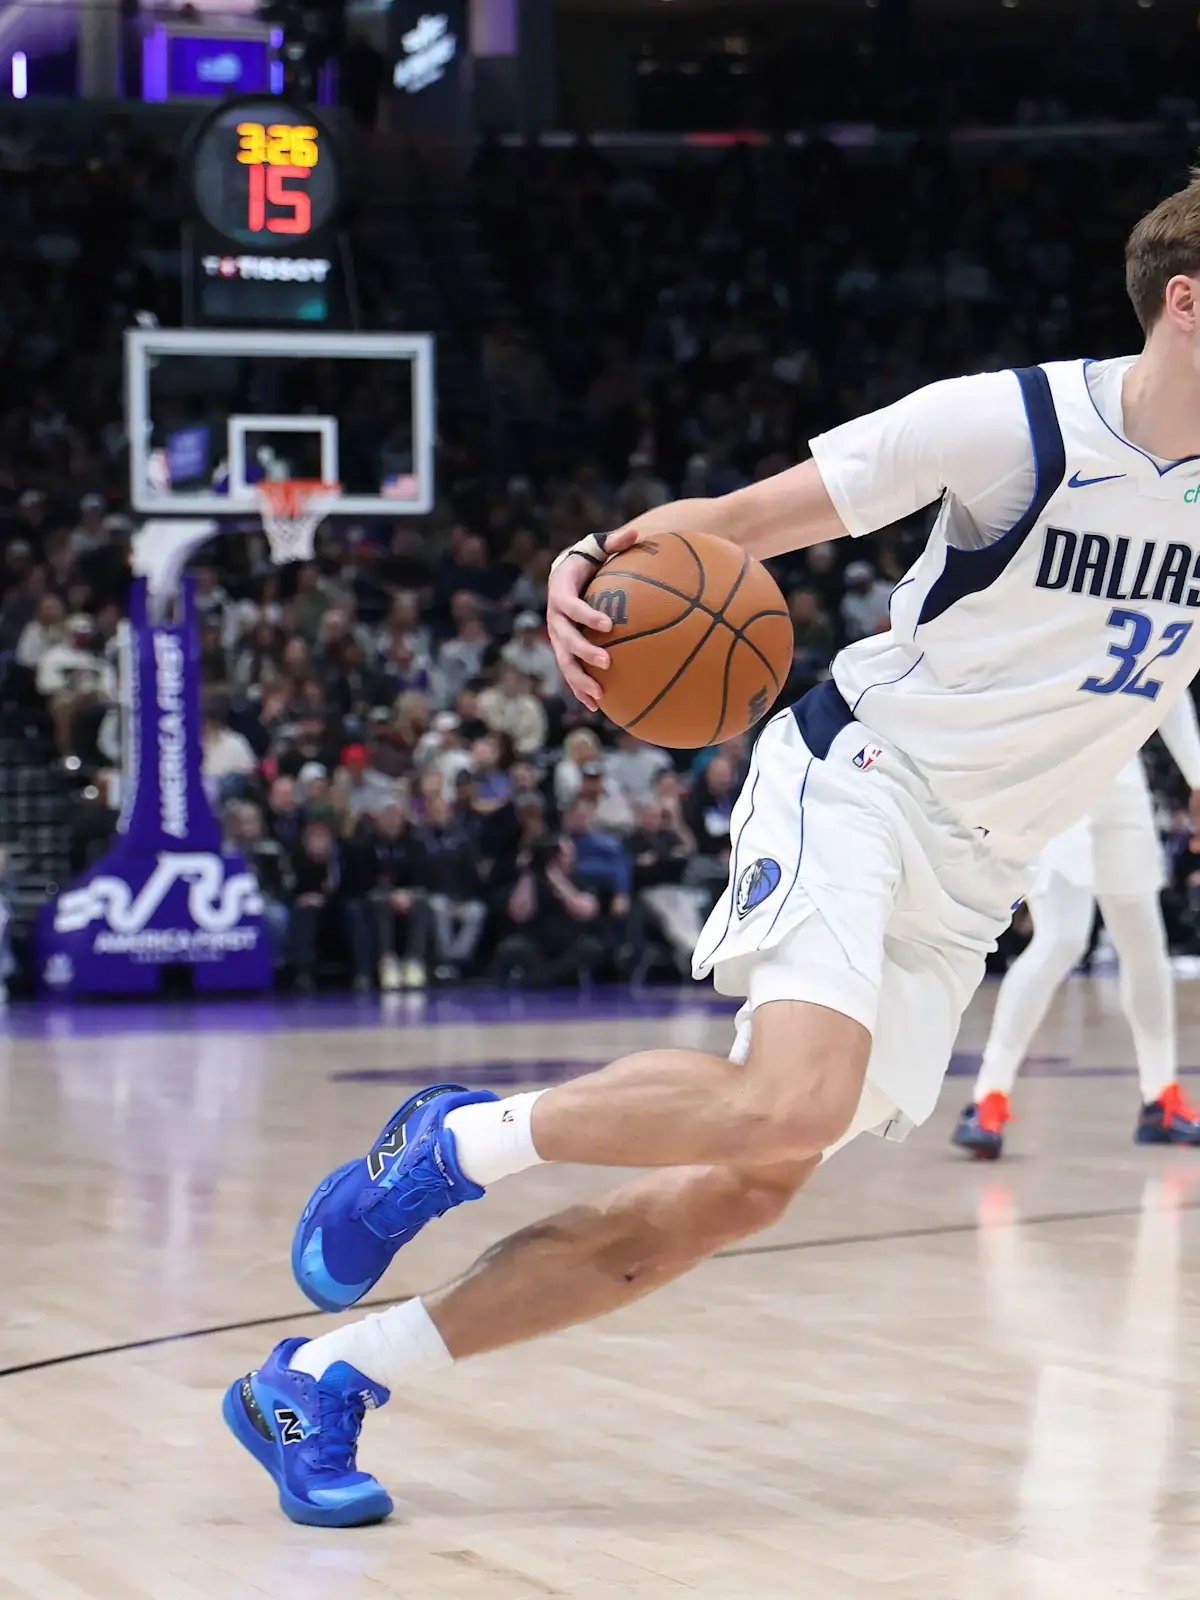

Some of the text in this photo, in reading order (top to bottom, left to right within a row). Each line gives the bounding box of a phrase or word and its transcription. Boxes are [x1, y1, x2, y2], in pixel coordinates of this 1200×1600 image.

[248, 163, 311, 234] 15
[237, 255, 331, 282] TISSOT
[1076, 606, 1194, 702] 32
